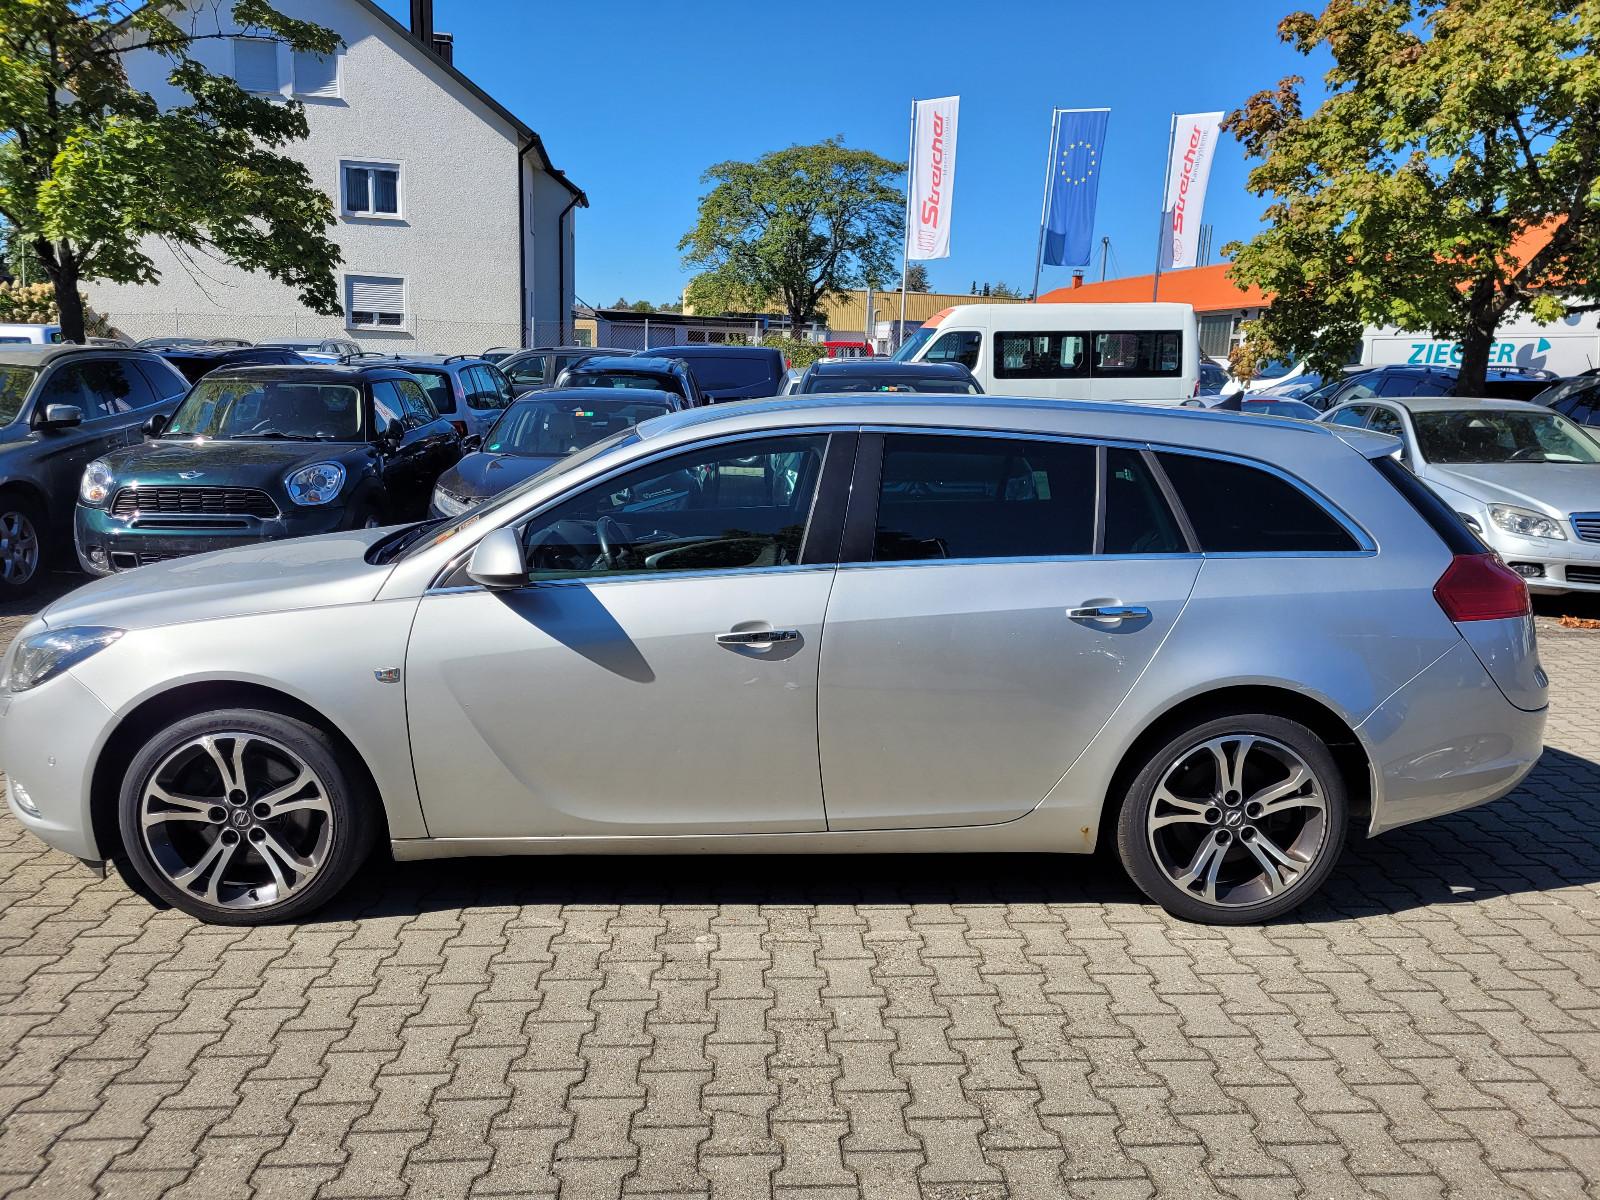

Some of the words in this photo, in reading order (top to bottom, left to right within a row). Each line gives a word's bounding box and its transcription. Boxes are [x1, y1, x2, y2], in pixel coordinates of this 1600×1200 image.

[921, 110, 944, 229] Streicher
[1172, 124, 1202, 236] Streicher
[1407, 342, 1516, 365] ZIEGER
